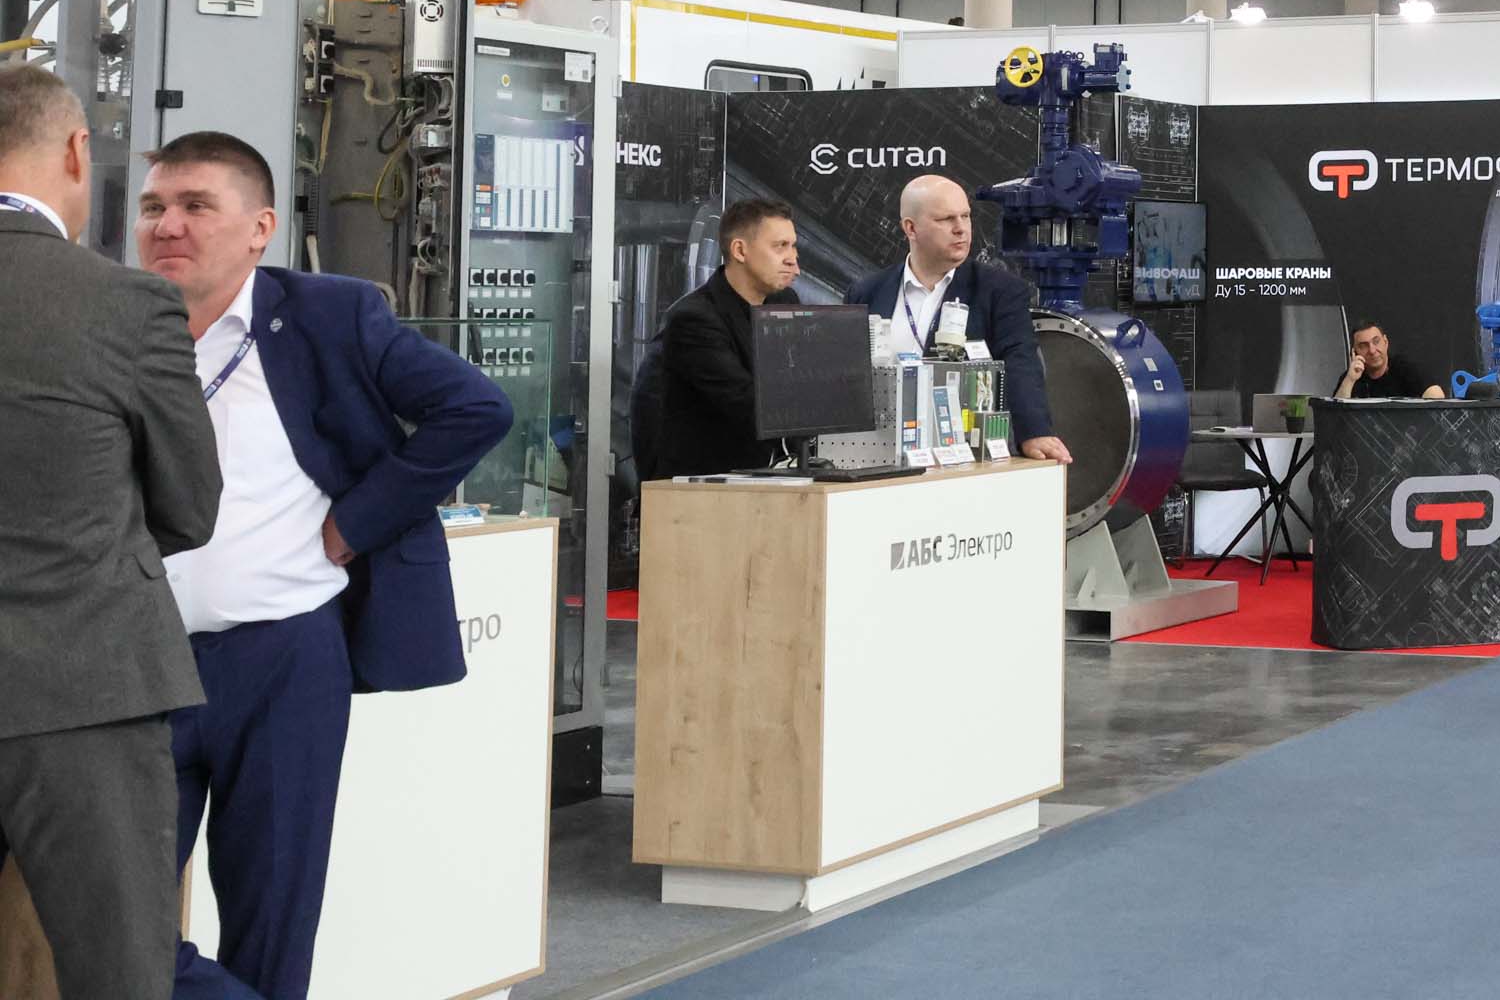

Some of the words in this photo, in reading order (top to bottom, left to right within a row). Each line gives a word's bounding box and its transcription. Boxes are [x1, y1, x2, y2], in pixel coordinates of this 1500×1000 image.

[1215, 267, 1283, 280] ШАРОВЫЕ
[1285, 267, 1332, 279] КРАНЫ
[1215, 284, 1232, 298] Ду
[1235, 284, 1246, 296] 15
[1258, 284, 1287, 296] 1200
[1290, 287, 1306, 296] мм
[907, 535, 943, 568] АБС
[947, 531, 1013, 560] Электро
